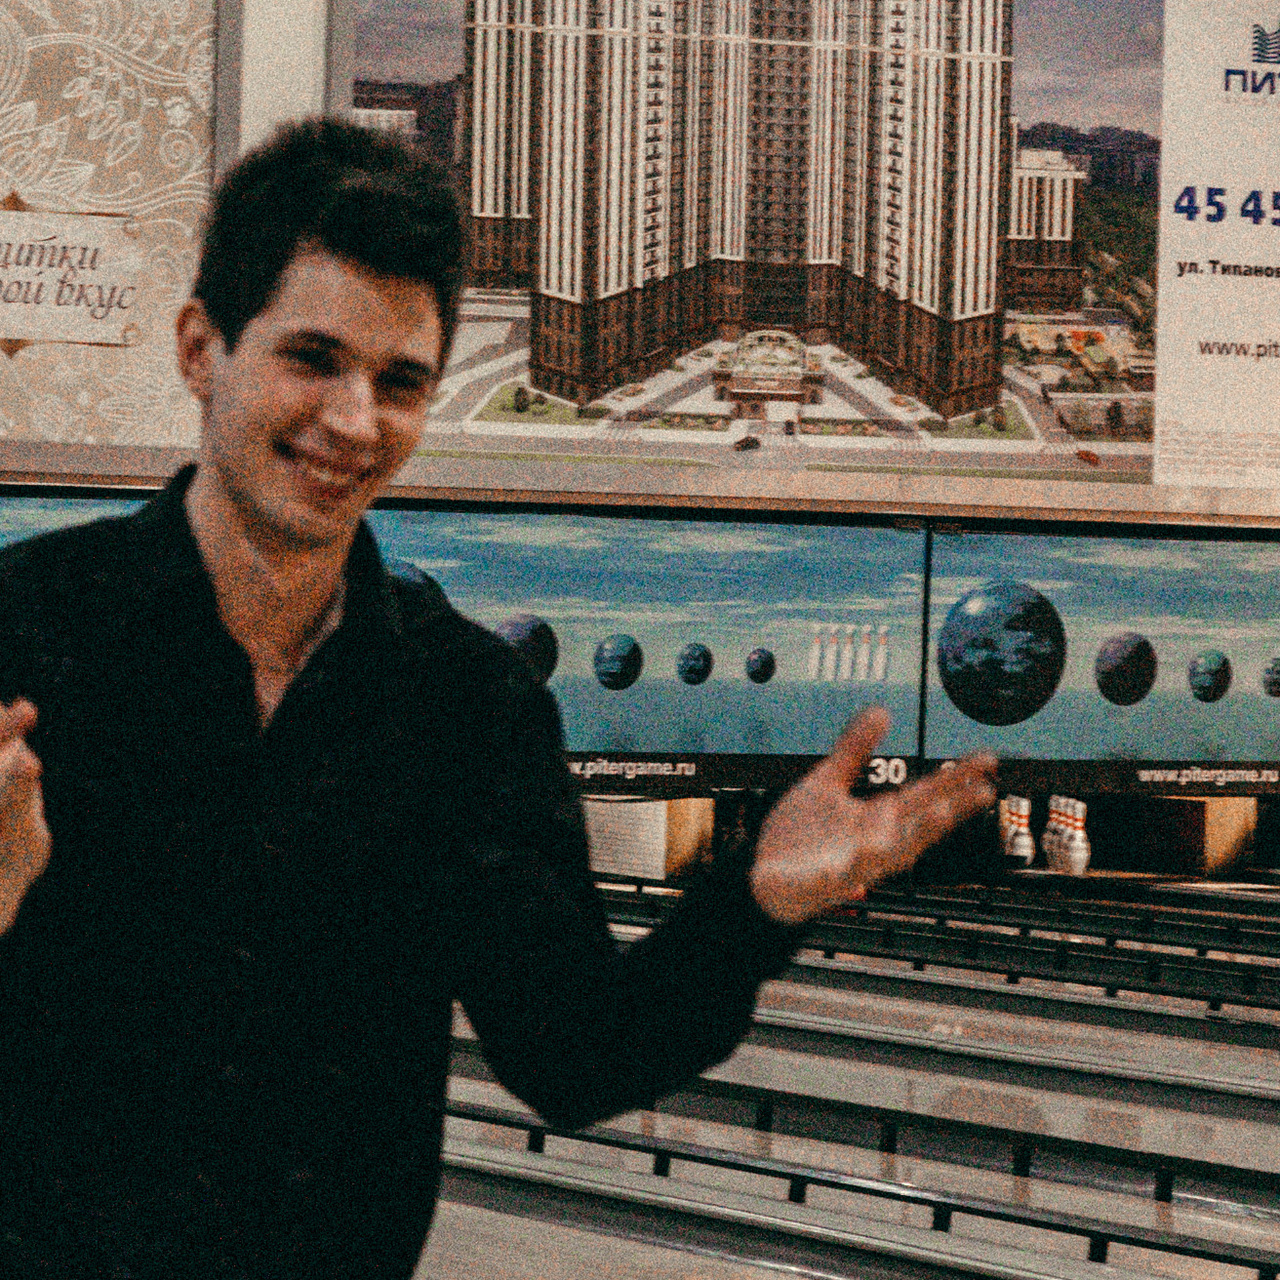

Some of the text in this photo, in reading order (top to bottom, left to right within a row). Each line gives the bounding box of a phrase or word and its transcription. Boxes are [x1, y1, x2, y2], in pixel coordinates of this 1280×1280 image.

[1224, 68, 1280, 95] ПИ
[1174, 185, 1227, 223] 45
[1176, 260, 1204, 278] ул.
[55, 269, 137, 321] вкус
[867, 757, 907, 785] 30
